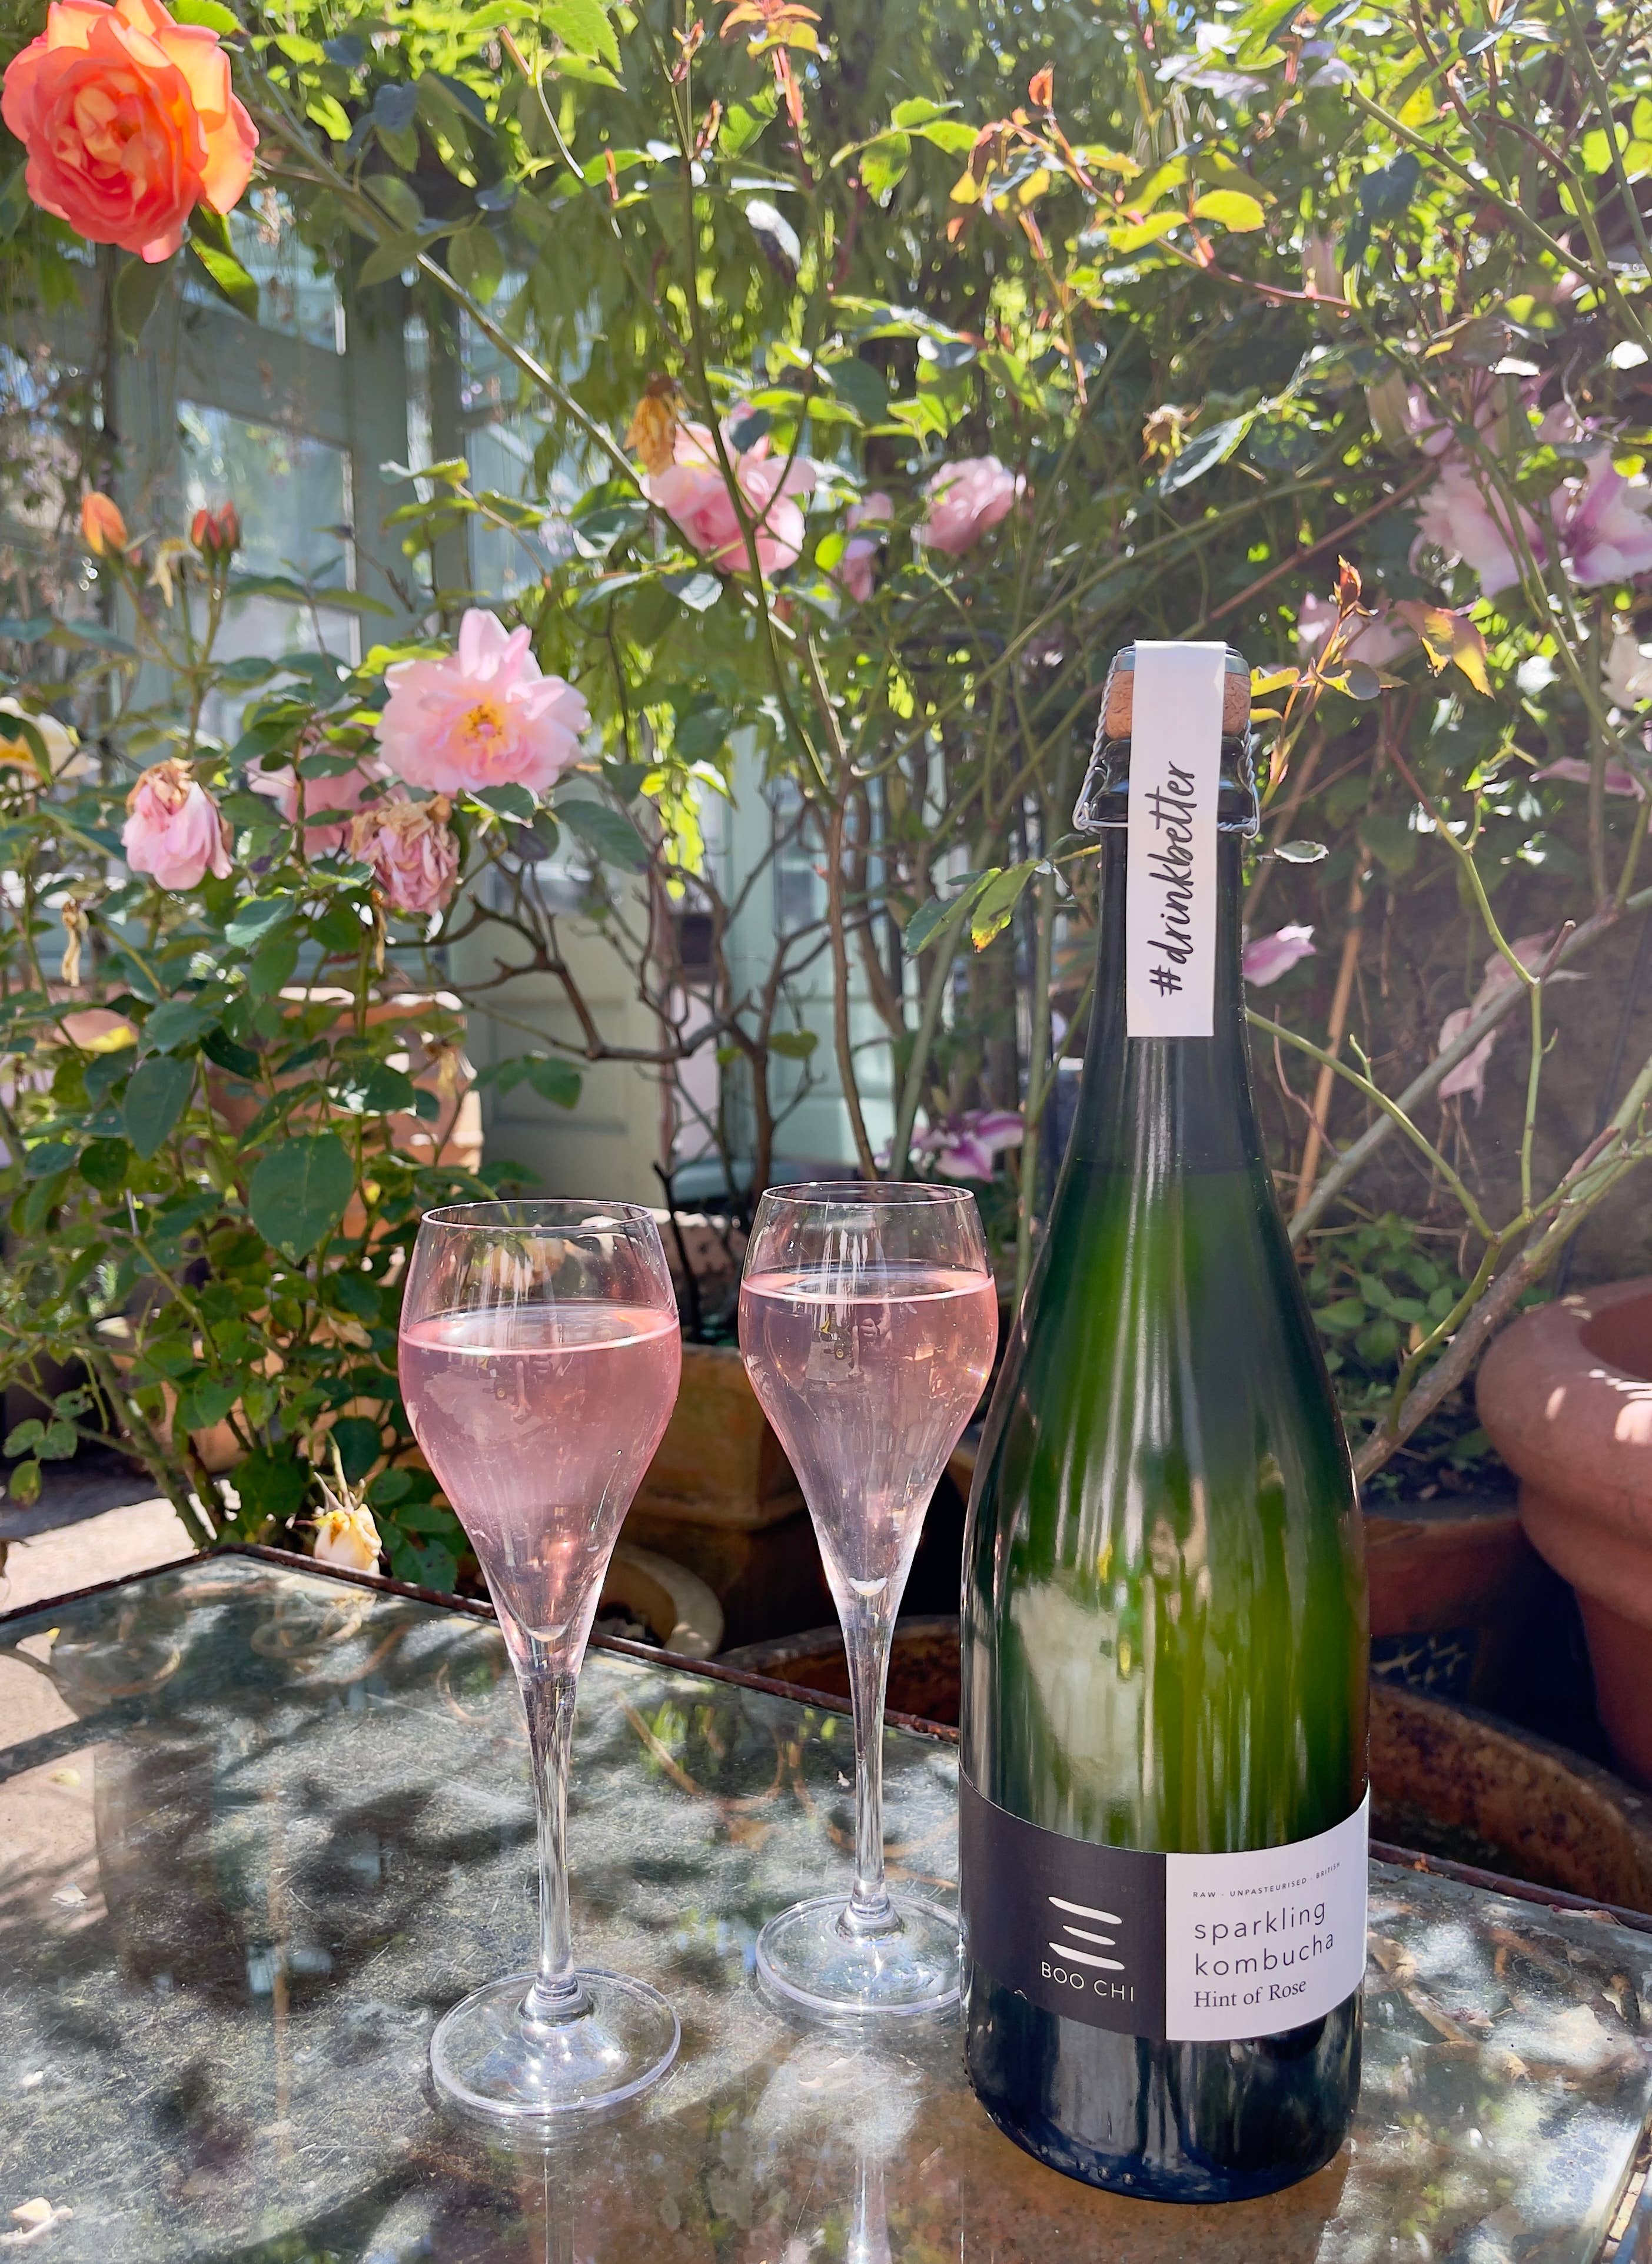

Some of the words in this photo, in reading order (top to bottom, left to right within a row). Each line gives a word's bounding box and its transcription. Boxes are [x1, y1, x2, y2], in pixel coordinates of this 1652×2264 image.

[1144, 760, 1198, 998] #drinkbetter
[1229, 1877, 1308, 1897] UNPASTEURISED
[1315, 1861, 1341, 1879] BRITISH
[1194, 1901, 1326, 1946] sparkling
[1195, 1933, 1334, 1976] kombucha
[1041, 1960, 1085, 1990] BOO
[1093, 1979, 1135, 2003] CHI
[1194, 1991, 1238, 2008] Hint
[1242, 1986, 1264, 2007] of
[1268, 1979, 1307, 2002] Rose
